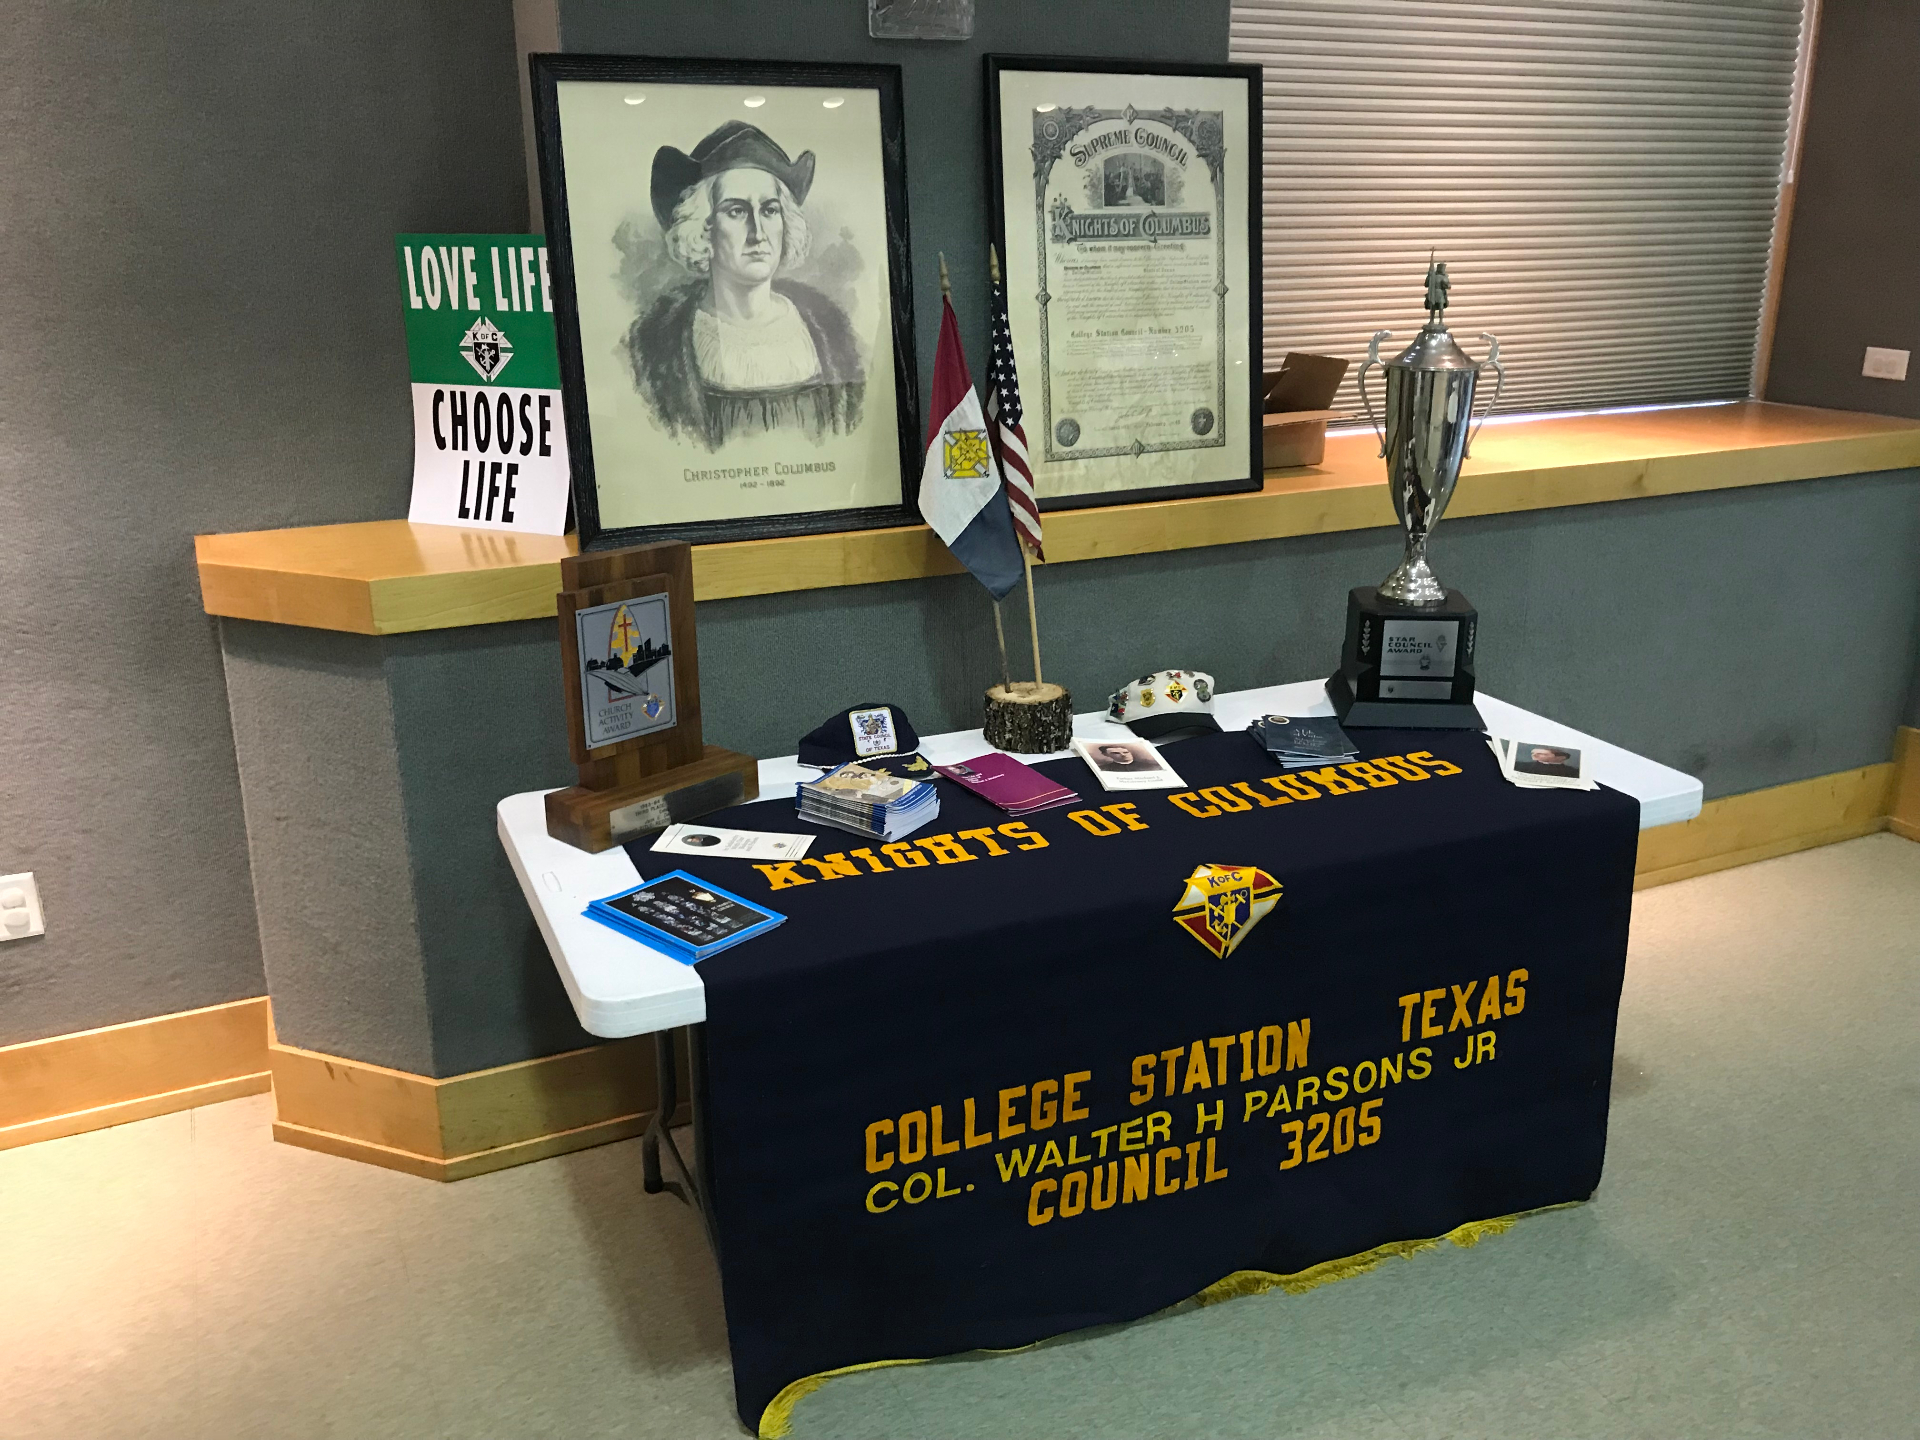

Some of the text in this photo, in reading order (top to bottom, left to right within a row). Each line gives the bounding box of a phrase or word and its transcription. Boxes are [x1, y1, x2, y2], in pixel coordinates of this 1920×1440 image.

[1069, 127, 1188, 169] SUPREME COUNCIL
[1054, 206, 1211, 244] KNIGHTS OF COLUMBUS
[404, 246, 553, 313] LOVE LIFE
[432, 388, 551, 457] CHOOSE
[458, 460, 519, 523] LIFE
[683, 461, 837, 483] CHRISTOPHER COLUMBUS
[598, 703, 632, 718] CHURCH
[599, 711, 635, 727] ACTIVITY
[602, 721, 632, 735] AWARD
[752, 821, 1050, 892] KNIGHTS
[1066, 802, 1151, 838] OF
[1167, 751, 1463, 819] COLUMBUS
[864, 968, 1529, 1173] COLLEGE STATION TEXAS
[865, 1030, 1497, 1214] COL. WALTER H PARSONS JR
[1027, 1098, 1384, 1227] COUNCIL 3205
